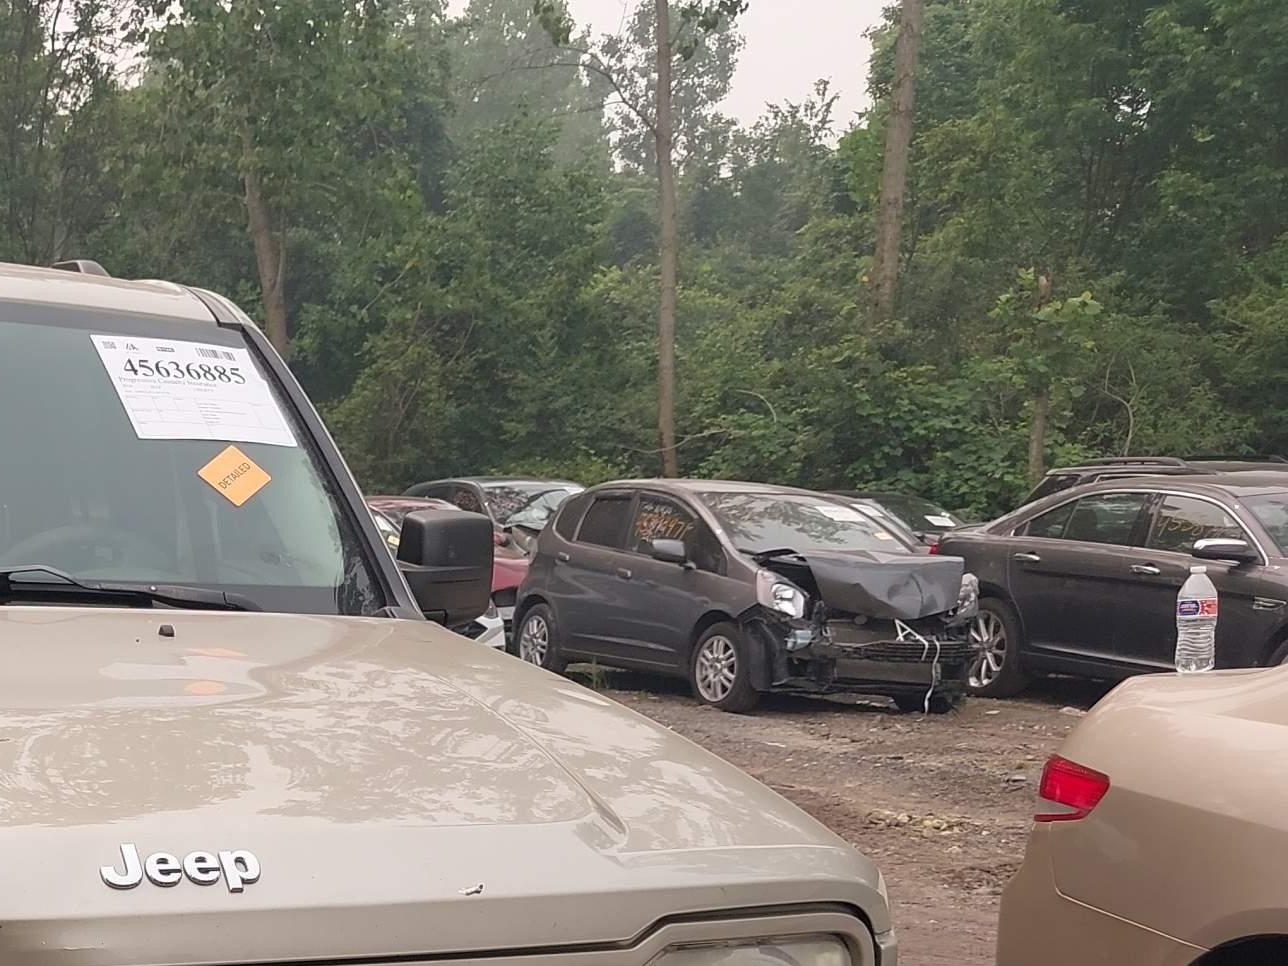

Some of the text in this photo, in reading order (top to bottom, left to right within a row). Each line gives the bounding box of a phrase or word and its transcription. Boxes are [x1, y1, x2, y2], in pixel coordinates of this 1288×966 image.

[123, 358, 246, 384] 45636885
[218, 462, 251, 489] DETAILED
[99, 841, 261, 893] Jeep
